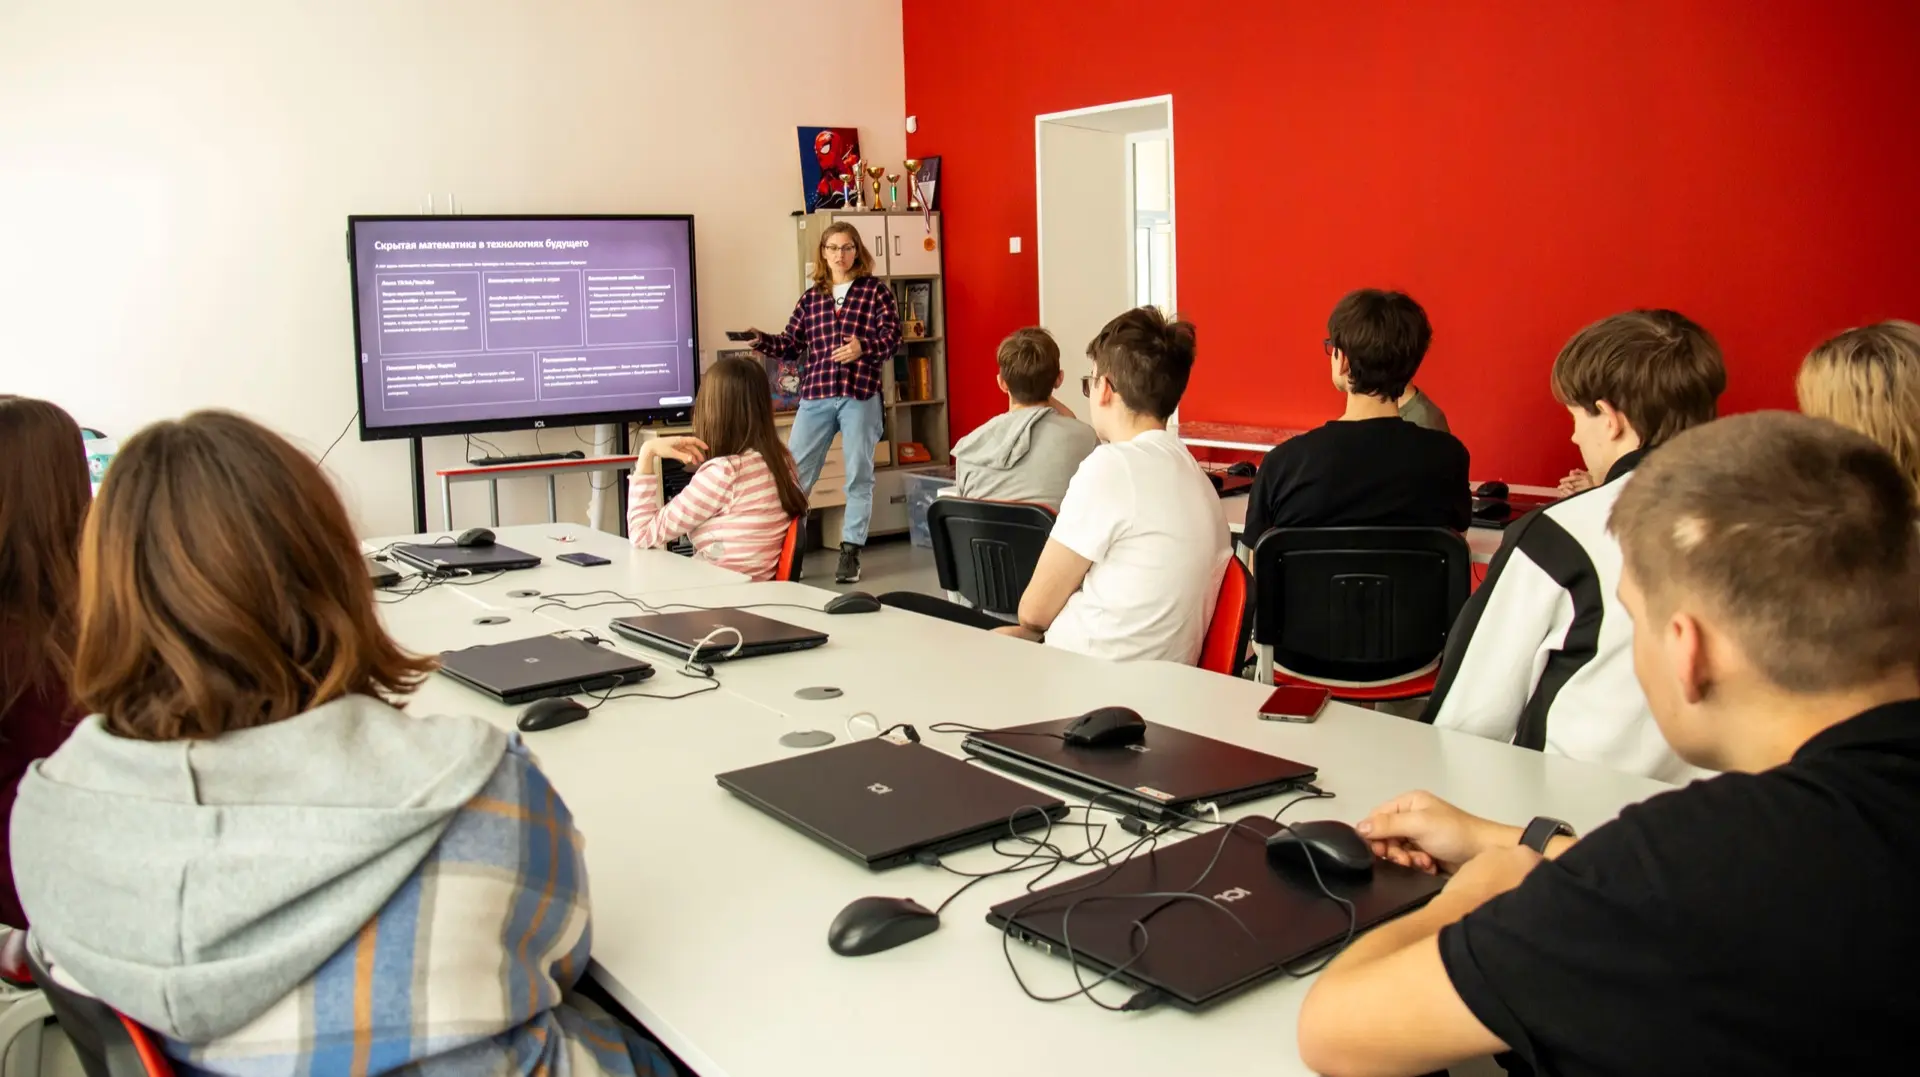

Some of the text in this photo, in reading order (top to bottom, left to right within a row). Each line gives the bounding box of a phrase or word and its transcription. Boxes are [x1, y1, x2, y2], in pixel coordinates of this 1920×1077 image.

[374, 238, 590, 252] Скрытая математика в технологиях будущего
